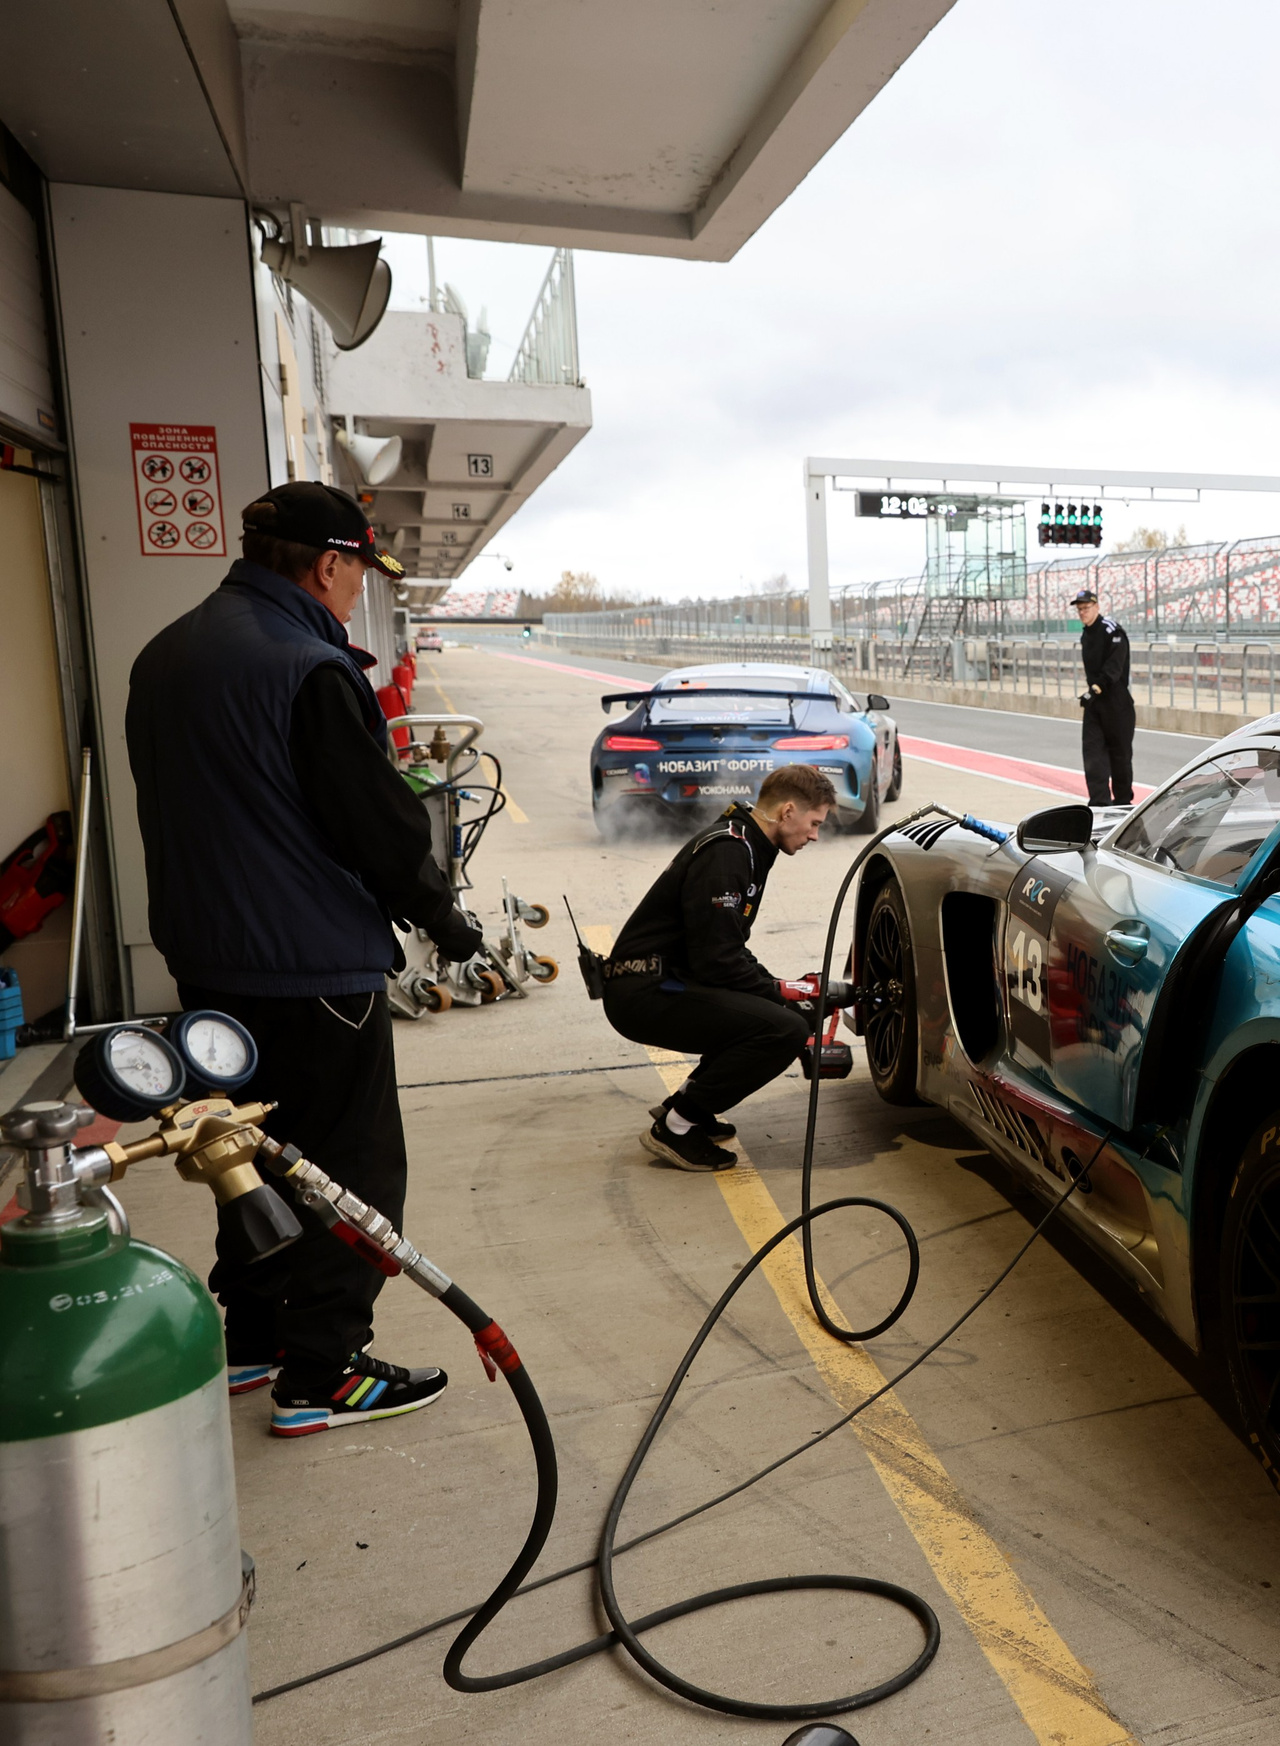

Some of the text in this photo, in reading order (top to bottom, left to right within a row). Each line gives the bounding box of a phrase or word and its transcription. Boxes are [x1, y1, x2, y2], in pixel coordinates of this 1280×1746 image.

[158, 427, 188, 435] ЗОНА
[133, 433, 214, 443] ПОВЫШЕННОЙ
[141, 441, 210, 450] ОПАСНОСТИ
[471, 458, 490, 474] 13
[455, 507, 469, 518] 14
[327, 537, 360, 549] ADVAN
[728, 759, 774, 772] ФОРТЕ
[699, 785, 751, 796] YOKOHAMA
[1013, 930, 1042, 1012] 13
